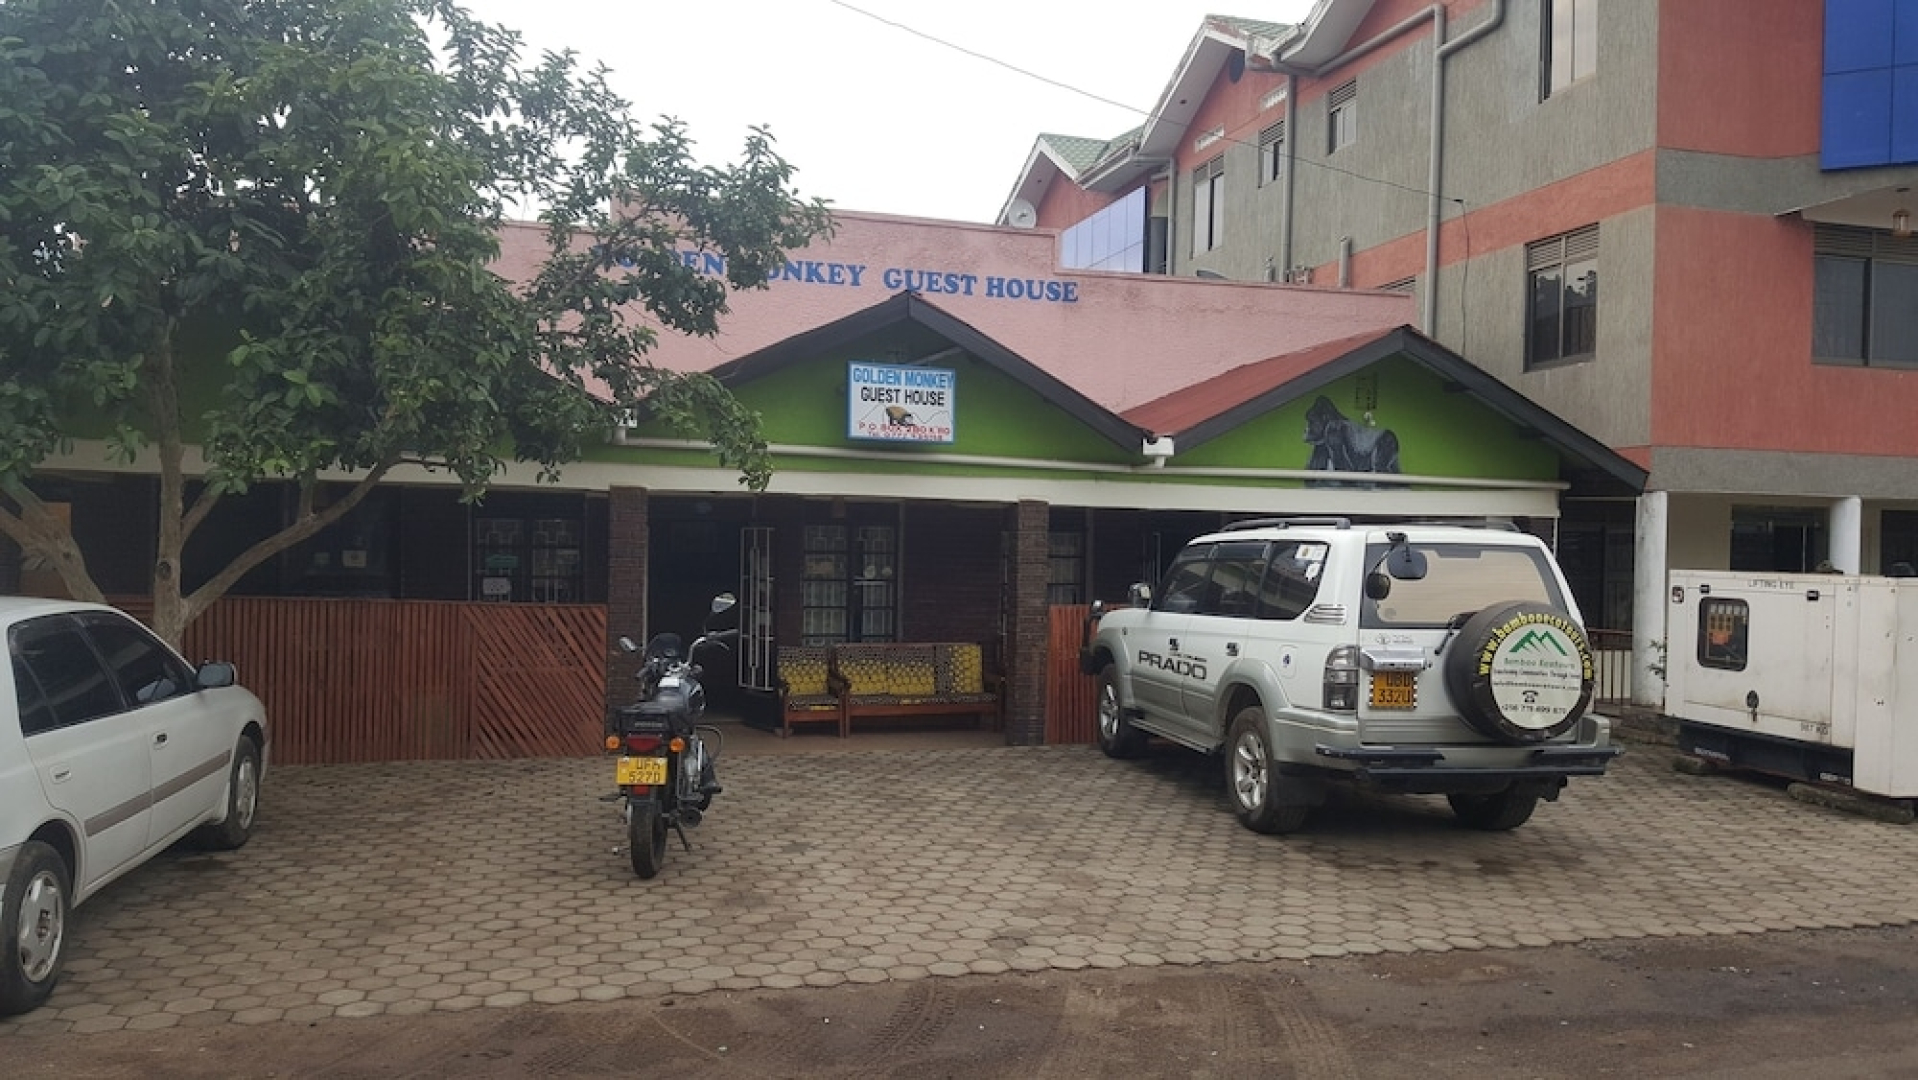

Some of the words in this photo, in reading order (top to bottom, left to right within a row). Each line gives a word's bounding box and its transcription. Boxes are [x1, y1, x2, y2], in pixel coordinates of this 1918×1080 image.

[883, 268, 977, 296] GUEST
[985, 276, 1079, 302] HOUSE
[853, 368, 902, 385] GOLDEN
[905, 371, 955, 388] MONKEY
[861, 386, 901, 403] GUEST
[904, 389, 946, 406] HOUSE
[1138, 649, 1207, 680] PRADO
[1378, 687, 1412, 704] 332U
